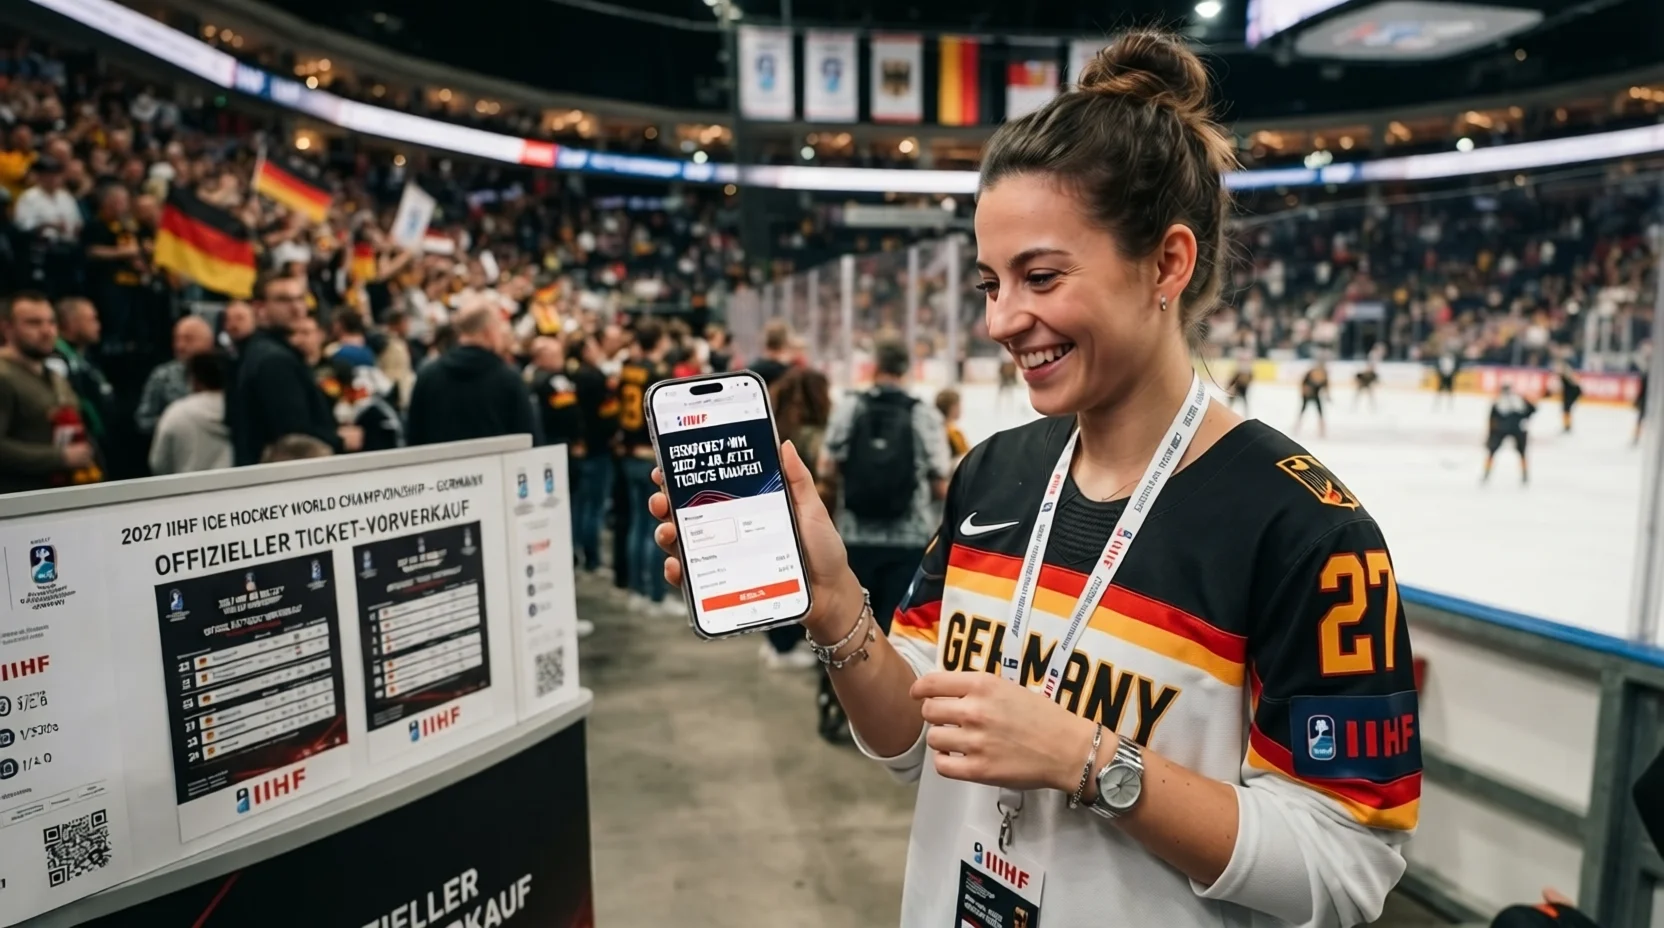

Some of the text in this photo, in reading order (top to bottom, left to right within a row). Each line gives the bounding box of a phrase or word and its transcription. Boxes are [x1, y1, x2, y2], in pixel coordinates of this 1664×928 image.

[121, 523, 162, 545] 2027
[166, 518, 198, 537] IIHF
[203, 513, 228, 531] ICE
[230, 503, 289, 527] HOCKEY
[291, 496, 336, 517] WORLD
[155, 499, 470, 576] OFFIZIELLER TICKET-VORVERKAUF
[1318, 550, 1399, 677] 27
[422, 706, 461, 737] IIHF
[1346, 714, 1414, 758] IIHF
[253, 767, 306, 805] IIHF
[445, 873, 532, 928] KAUF
